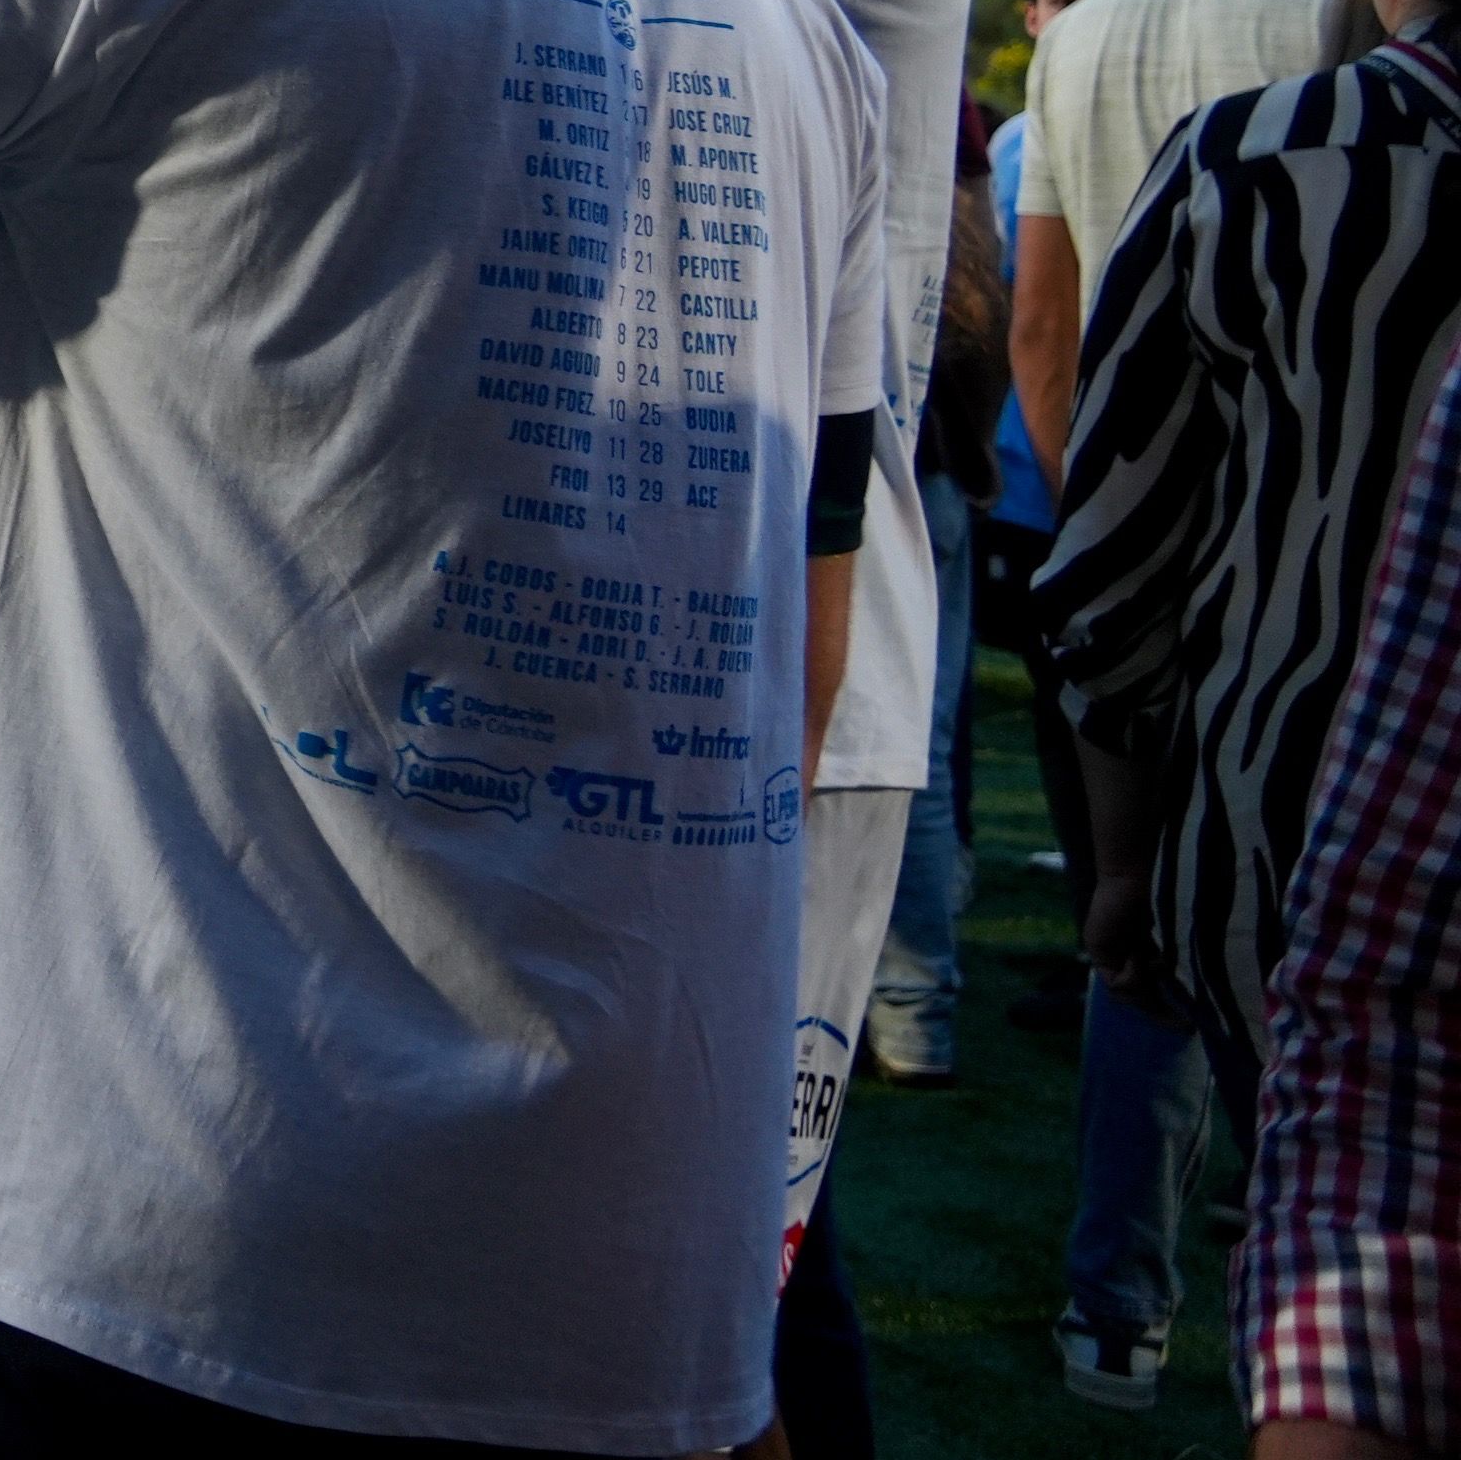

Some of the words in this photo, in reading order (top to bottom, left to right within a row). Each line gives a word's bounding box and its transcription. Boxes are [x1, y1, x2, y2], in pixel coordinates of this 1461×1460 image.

[534, 45, 607, 78] SERRANO
[667, 69, 713, 97] JESÚS
[669, 108, 706, 132] JOSE
[713, 112, 752, 138] CRUZ
[527, 144, 593, 186] GÁLVEZ
[675, 182, 717, 206] HUGO
[636, 141, 651, 165] 18
[699, 146, 759, 175] APONTE
[568, 201, 609, 227] KEIGO
[634, 214, 653, 238] 20
[501, 228, 561, 254] JAIME
[634, 251, 652, 275] 21
[678, 255, 742, 283] PEPOTE
[479, 264, 540, 291] MANU
[635, 289, 657, 313] 22
[680, 293, 759, 322] CASTILLA
[636, 326, 658, 350] 23
[682, 331, 737, 357] CANTY
[480, 338, 543, 368] DAVID
[637, 363, 660, 387] 24
[684, 369, 725, 395] TOLE
[639, 402, 662, 426] 25
[685, 406, 737, 434] BUDIA
[639, 441, 664, 466] 28
[687, 444, 751, 474] ZURERA
[639, 478, 663, 503] 29
[686, 483, 718, 510] ACE
[501, 494, 586, 531] LINARES
[606, 511, 626, 536] 14
[564, 767, 665, 826] GTL
